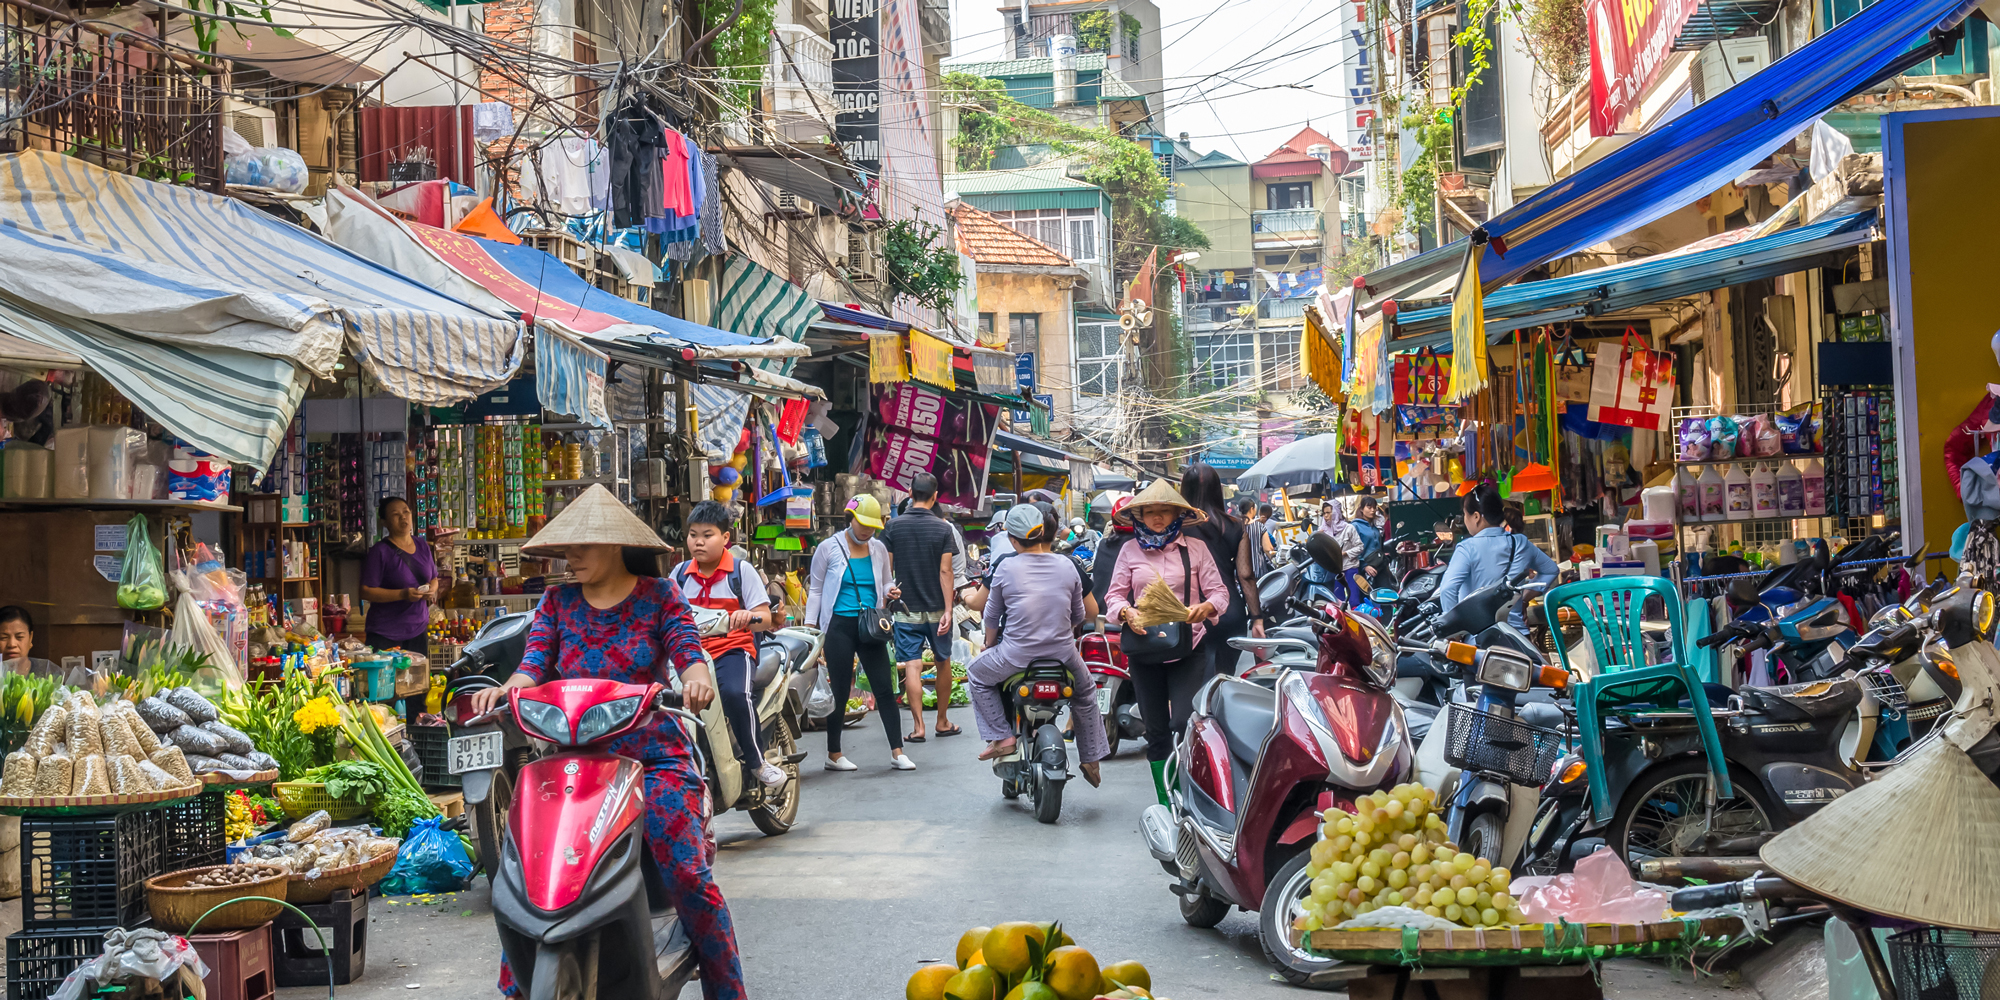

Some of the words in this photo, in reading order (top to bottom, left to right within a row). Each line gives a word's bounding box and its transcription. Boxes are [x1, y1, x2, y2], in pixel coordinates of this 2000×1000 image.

[836, 31, 870, 58] TÓC
[895, 382, 913, 428] CHERRY
[881, 432, 905, 480] CHERRY
[561, 684, 593, 693] YAMAHA
[456, 736, 494, 754] 30-F1
[456, 751, 495, 770] 6239
